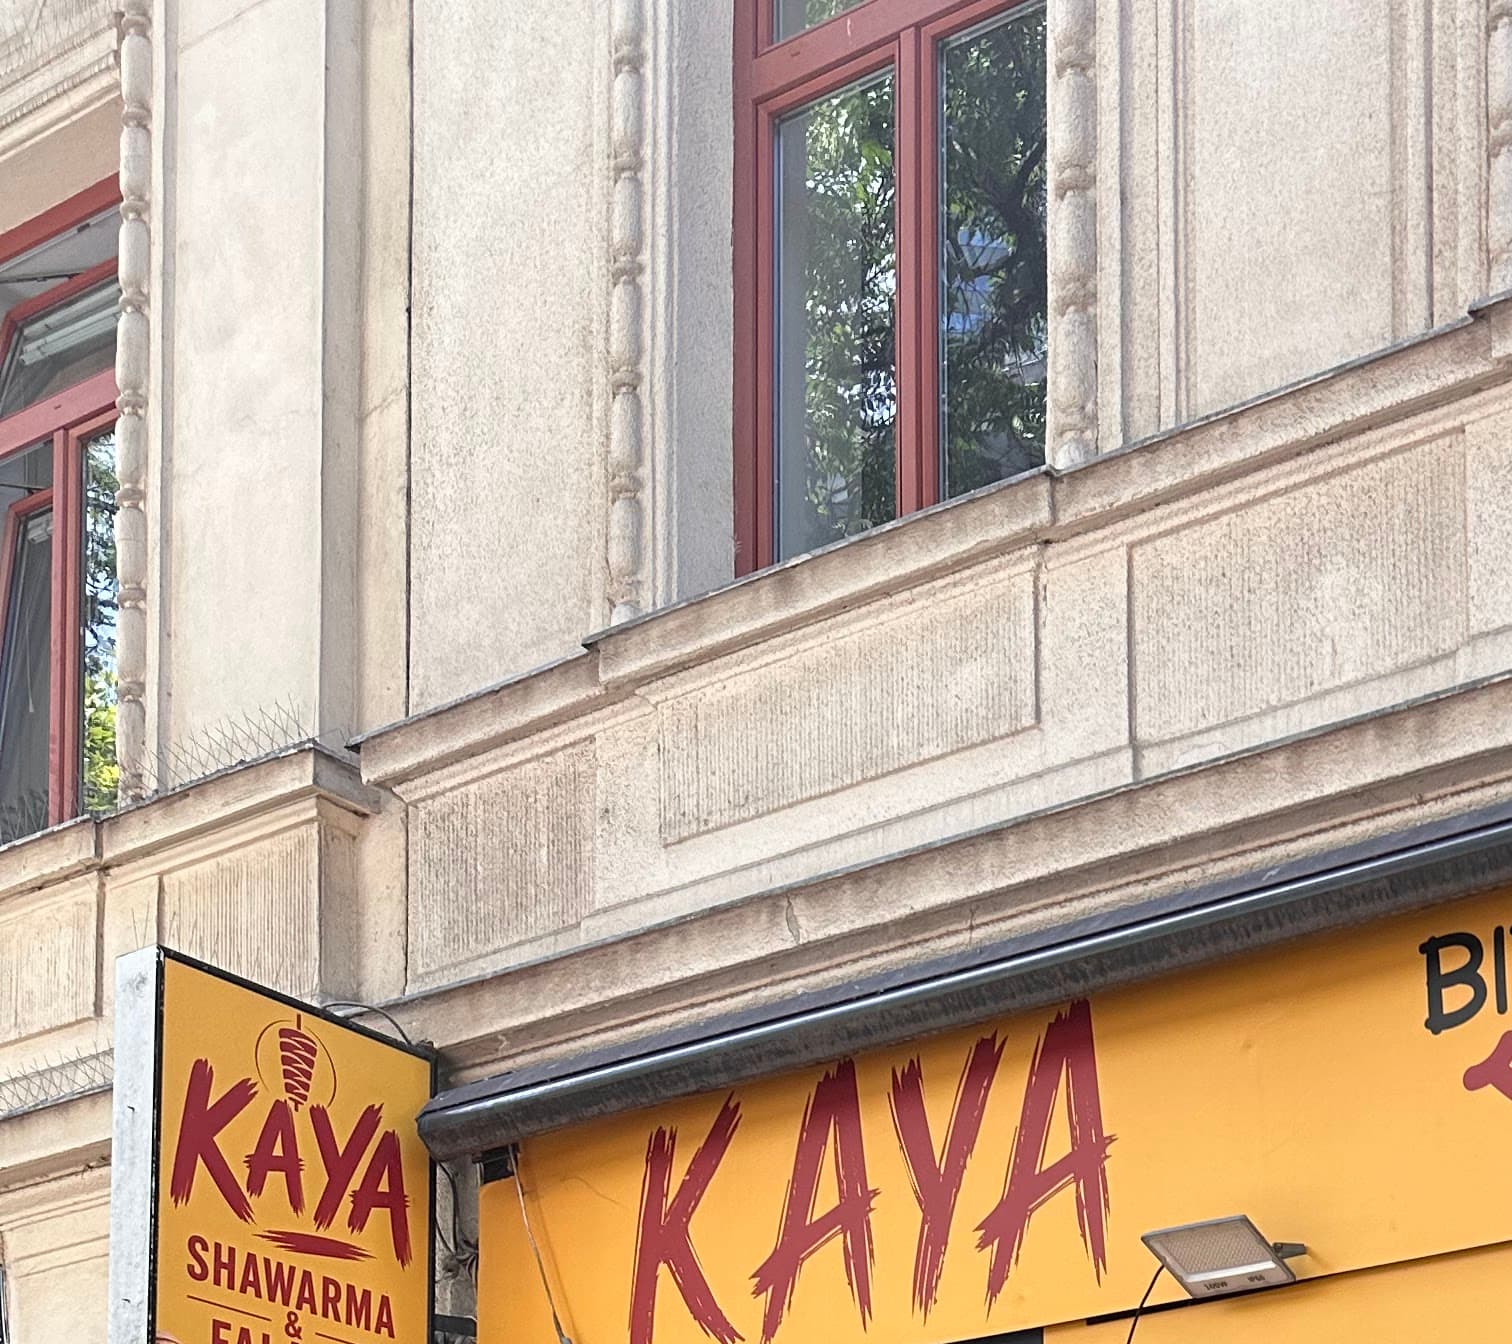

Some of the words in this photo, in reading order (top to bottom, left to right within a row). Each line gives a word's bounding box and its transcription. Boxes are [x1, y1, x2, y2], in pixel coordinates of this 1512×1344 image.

[169, 1056, 412, 1272] KAYA
[187, 1235, 396, 1340] SHAWARMA
[284, 1310, 303, 1340] &
